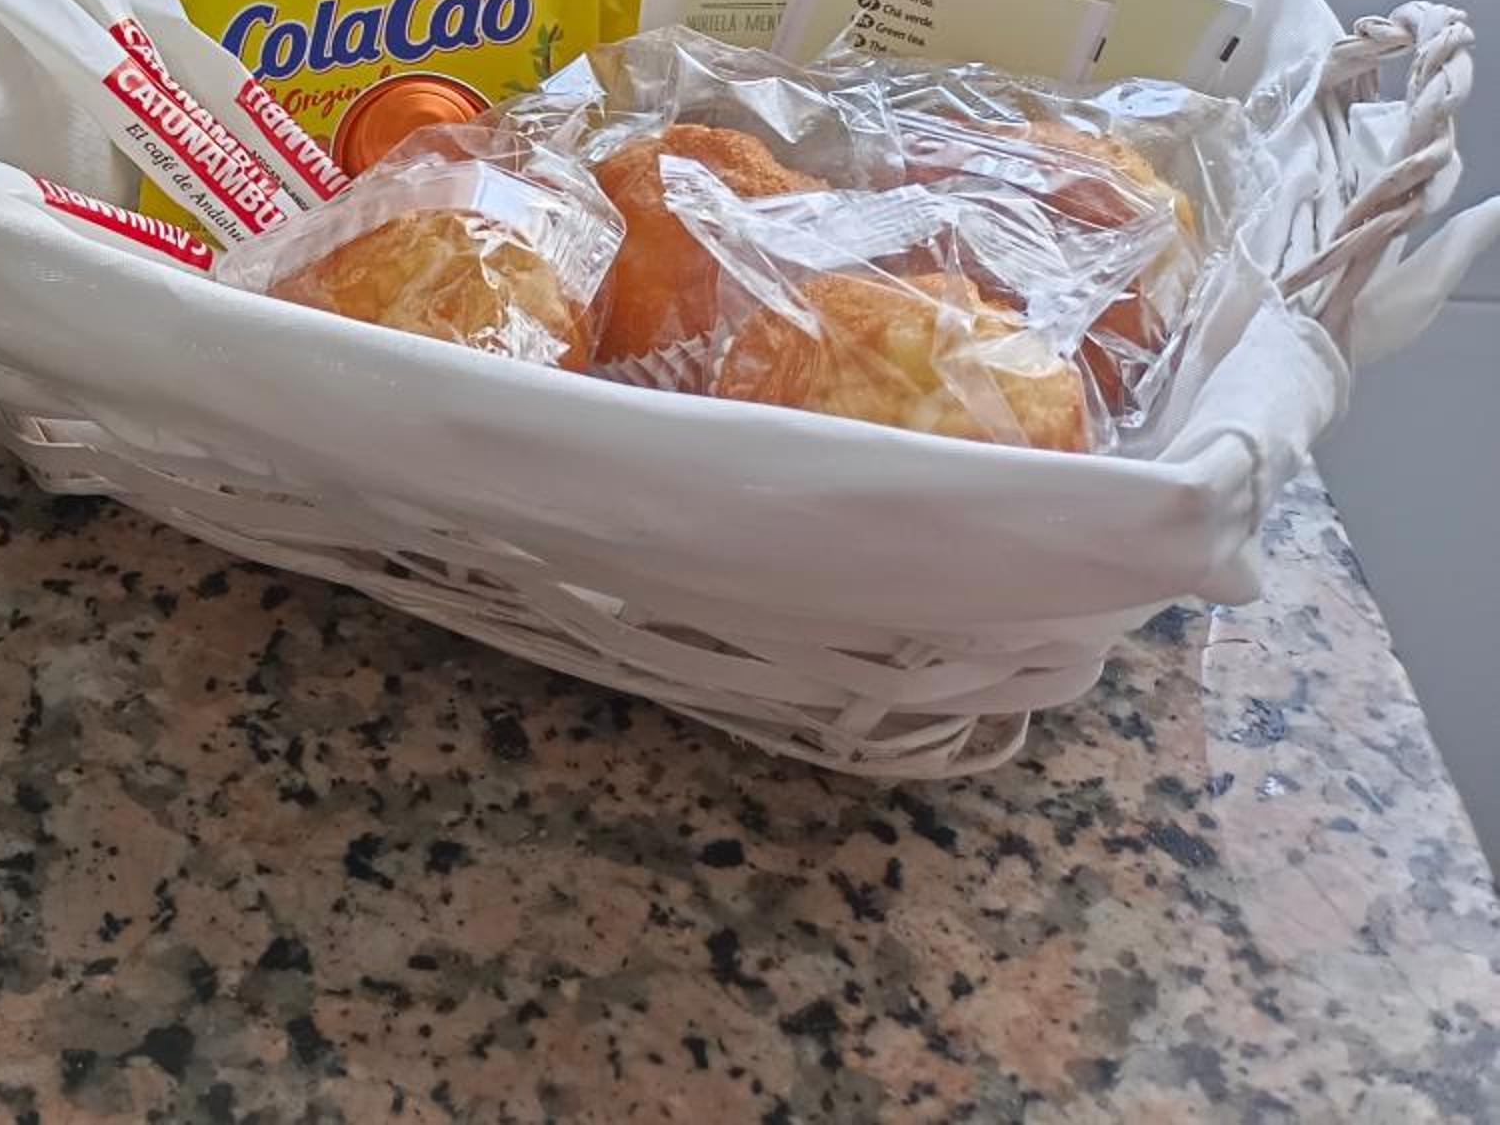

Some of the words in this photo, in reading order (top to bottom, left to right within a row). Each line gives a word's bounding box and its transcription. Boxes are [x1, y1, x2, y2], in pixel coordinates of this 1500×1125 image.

[126, 123, 149, 141] El
[144, 141, 178, 172] café
[173, 172, 194, 192] de
